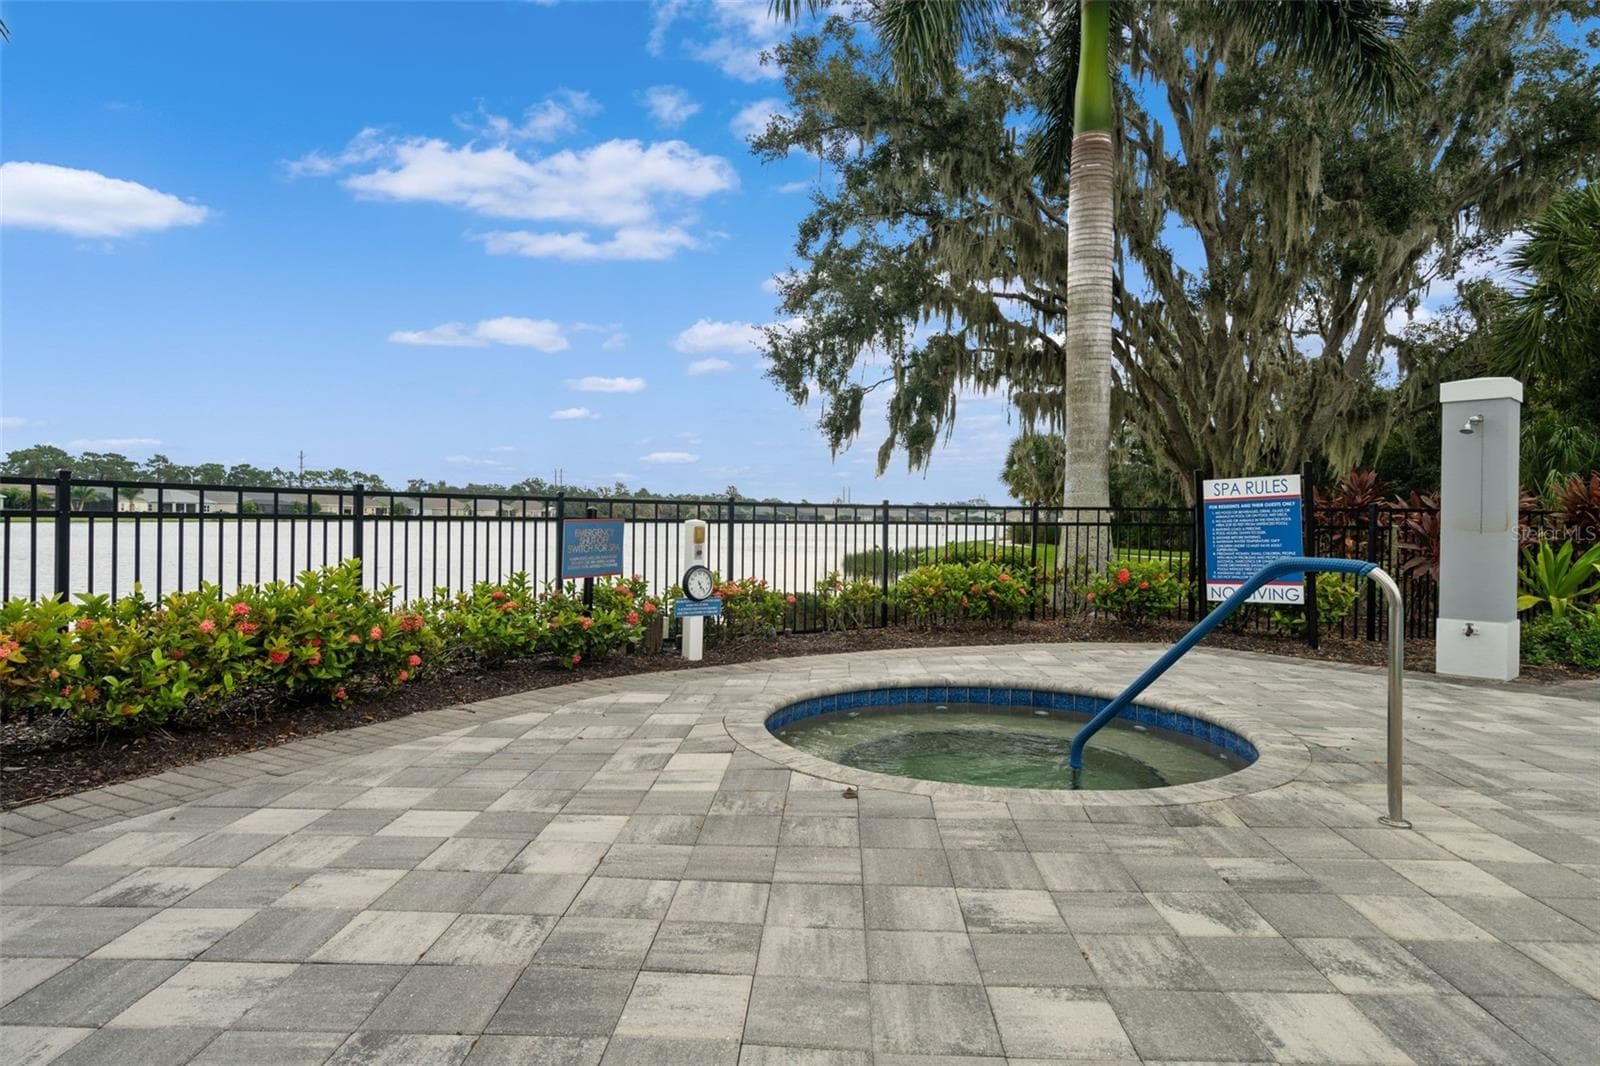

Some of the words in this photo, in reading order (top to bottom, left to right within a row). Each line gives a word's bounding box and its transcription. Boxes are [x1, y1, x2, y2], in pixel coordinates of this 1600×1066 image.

[1213, 482, 1241, 497] SPA
[1245, 478, 1289, 496] RULES
[1211, 586, 1237, 600] NO
[1246, 587, 1300, 602] IVING
